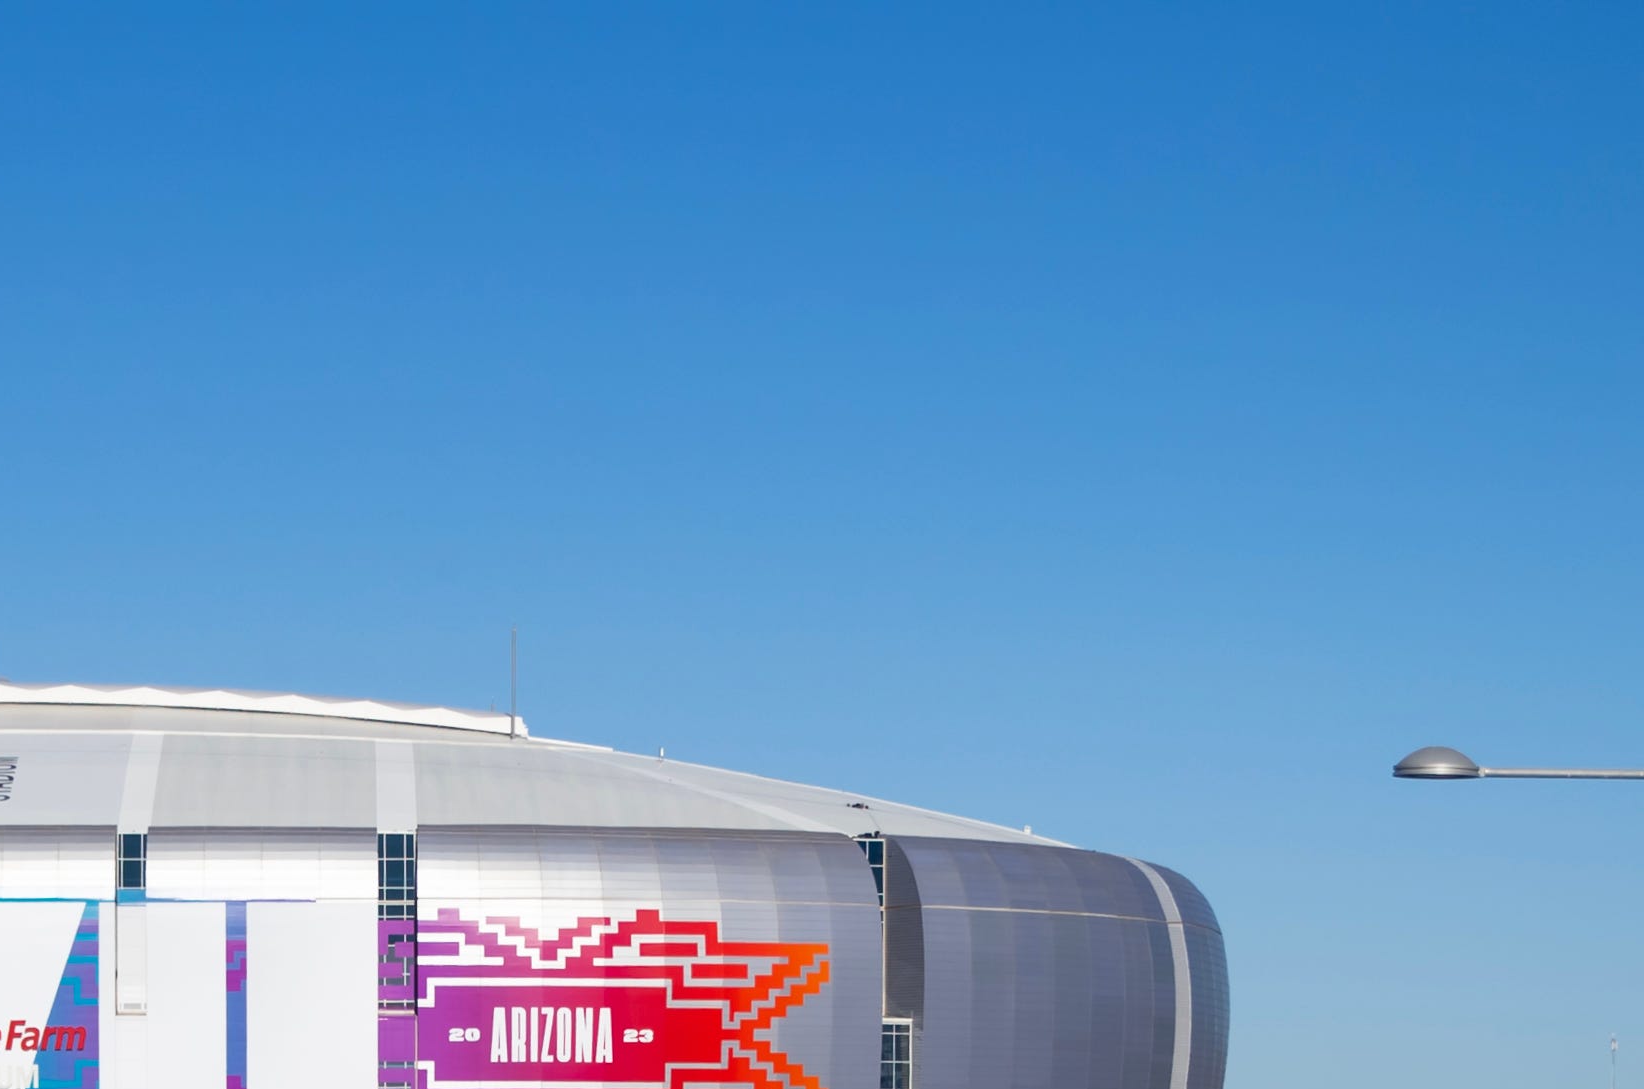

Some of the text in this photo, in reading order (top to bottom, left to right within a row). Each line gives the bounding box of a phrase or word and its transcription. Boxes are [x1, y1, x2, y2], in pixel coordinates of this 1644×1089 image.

[448, 1006, 655, 1064] 20 ARIZONA 23
